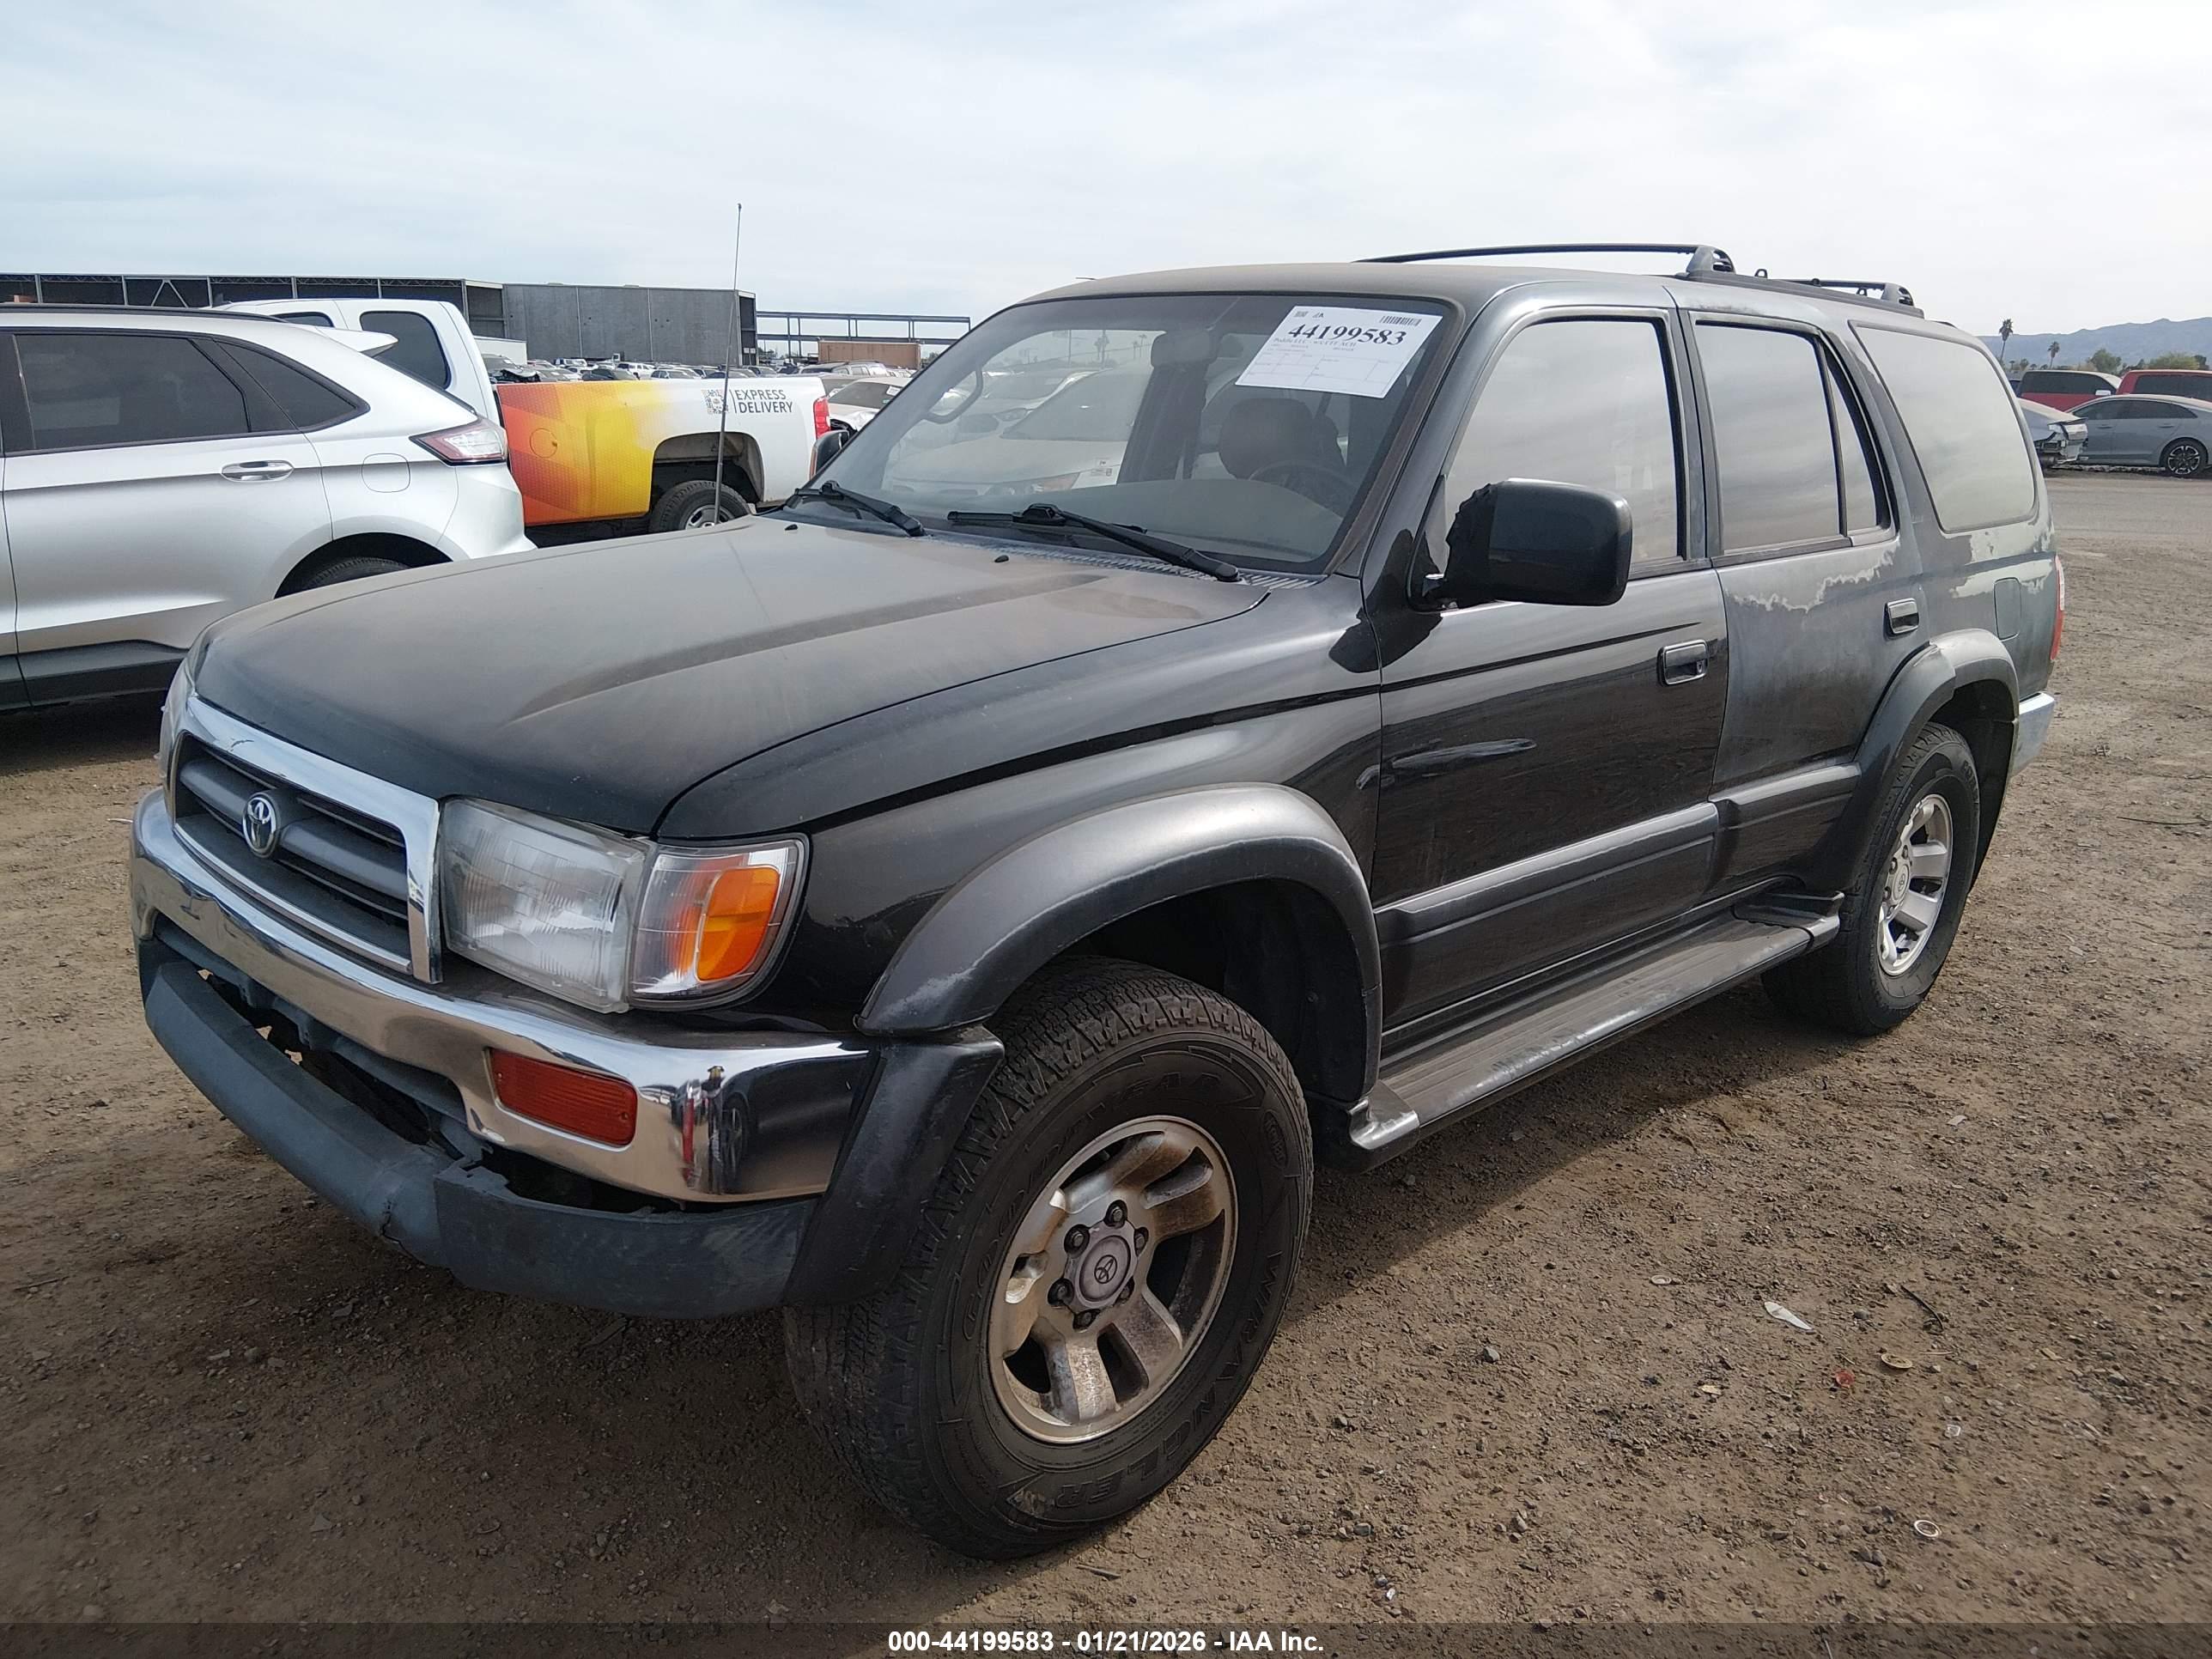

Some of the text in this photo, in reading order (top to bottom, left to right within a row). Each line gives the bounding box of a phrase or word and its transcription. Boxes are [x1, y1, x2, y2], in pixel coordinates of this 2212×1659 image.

[1288, 324, 1407, 345] 44199583
[735, 389, 786, 400] EXPRESS
[738, 401, 793, 413] DELIVERY
